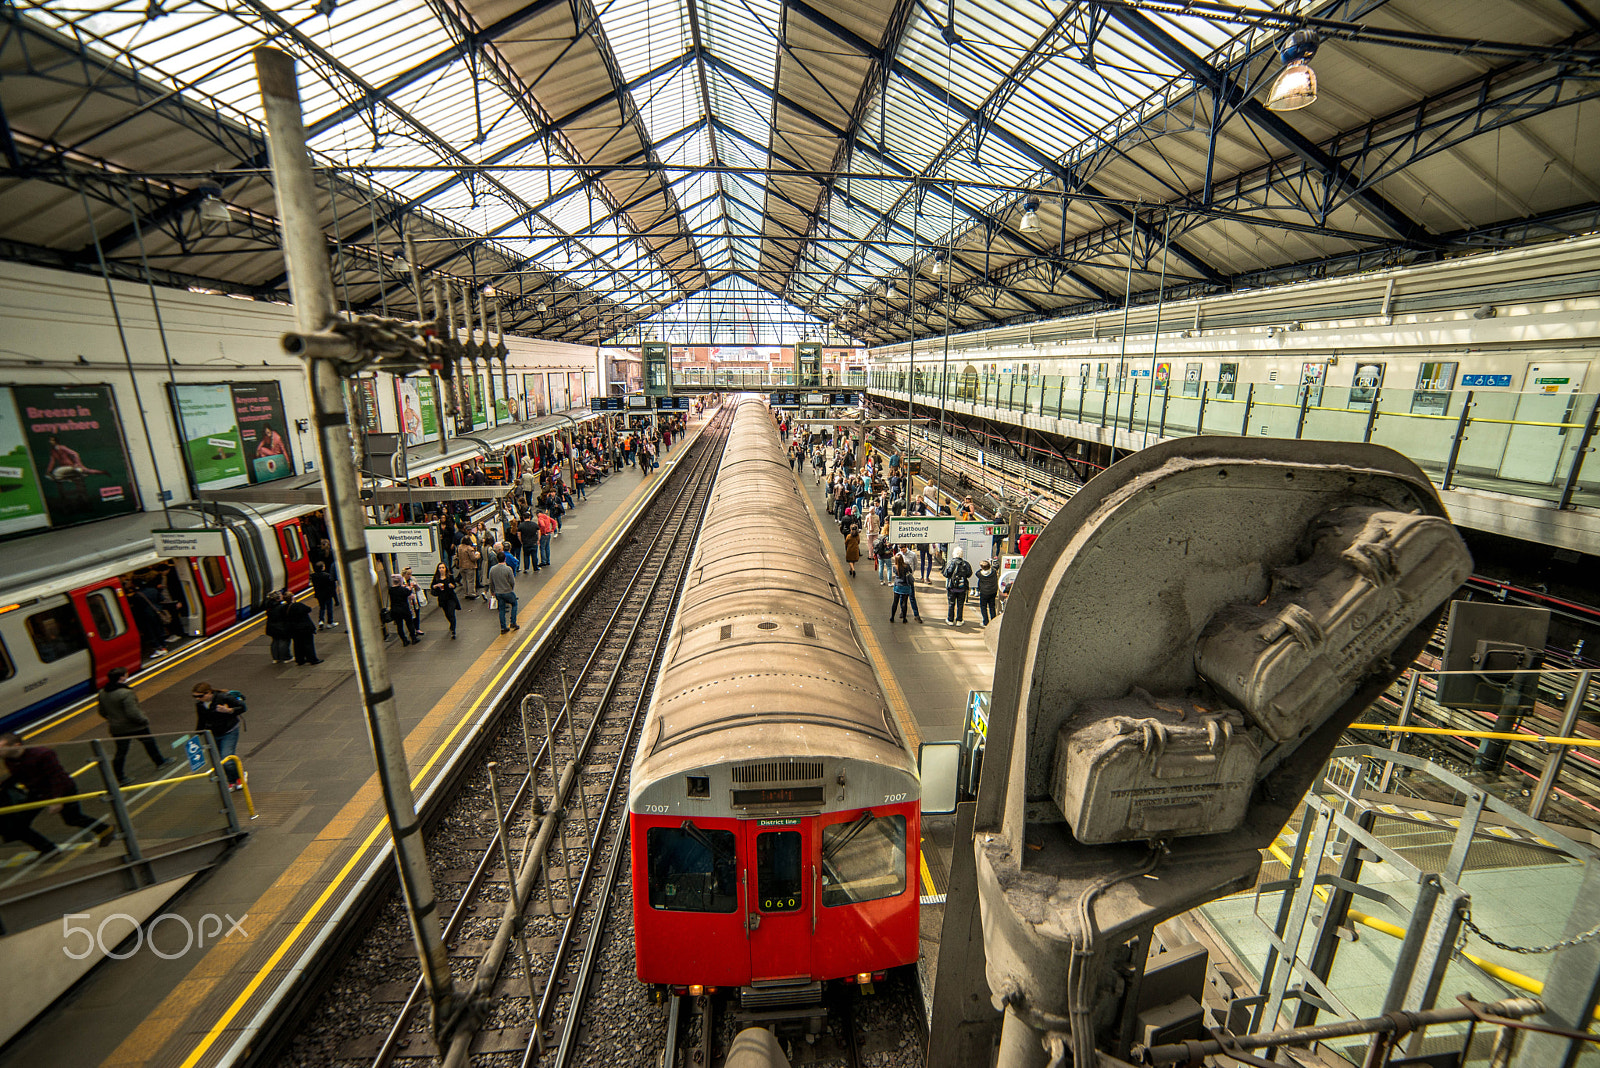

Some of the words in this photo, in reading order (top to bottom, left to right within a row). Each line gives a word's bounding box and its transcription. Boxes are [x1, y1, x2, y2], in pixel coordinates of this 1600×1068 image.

[1220, 372, 1235, 382] SUN
[1303, 375, 1320, 385] SAT
[1359, 376, 1375, 387] FRI
[1422, 378, 1449, 390] THU
[26, 406, 77, 419] Breeze
[77, 404, 92, 416] in
[31, 419, 100, 434] anywhere
[884, 792, 907, 803] 7007
[645, 804, 669, 813] 7007
